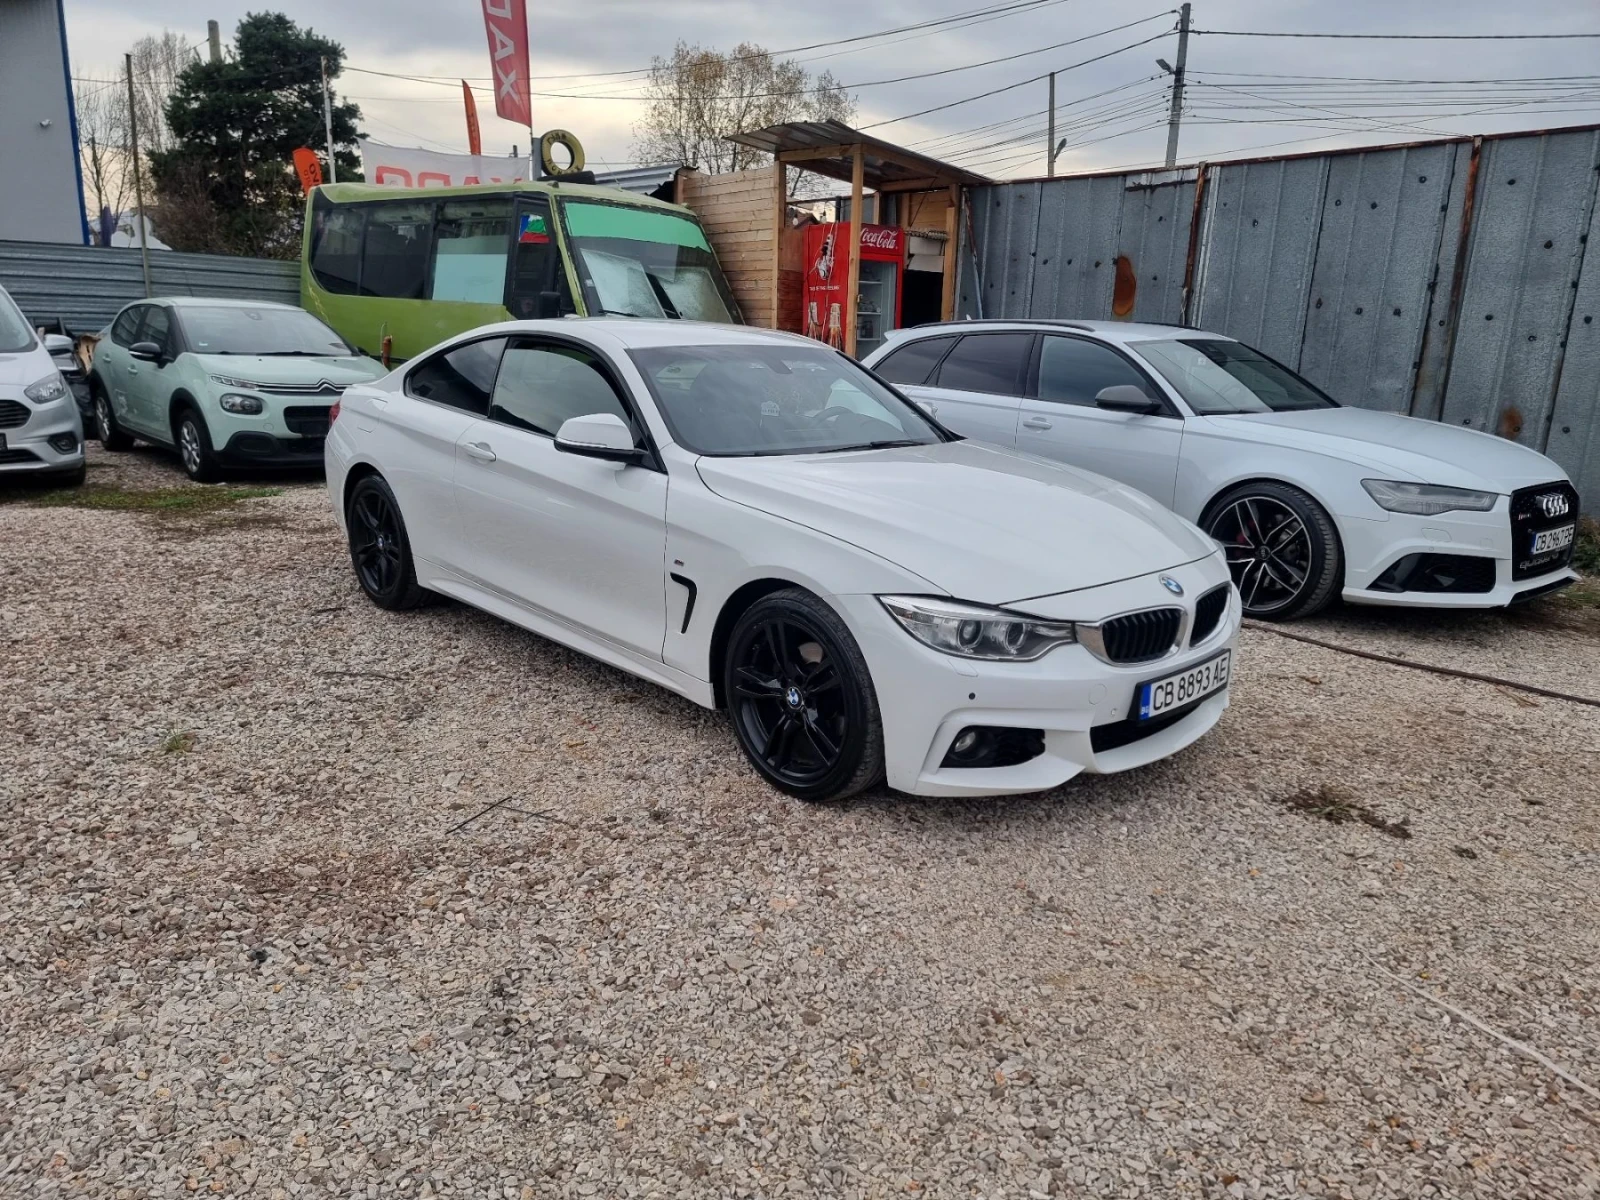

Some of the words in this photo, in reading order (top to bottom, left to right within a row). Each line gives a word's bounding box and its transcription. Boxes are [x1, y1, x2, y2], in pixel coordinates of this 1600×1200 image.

[1153, 681, 1174, 711] CB
[1177, 666, 1210, 702] 8893
[1212, 657, 1227, 687] AE
